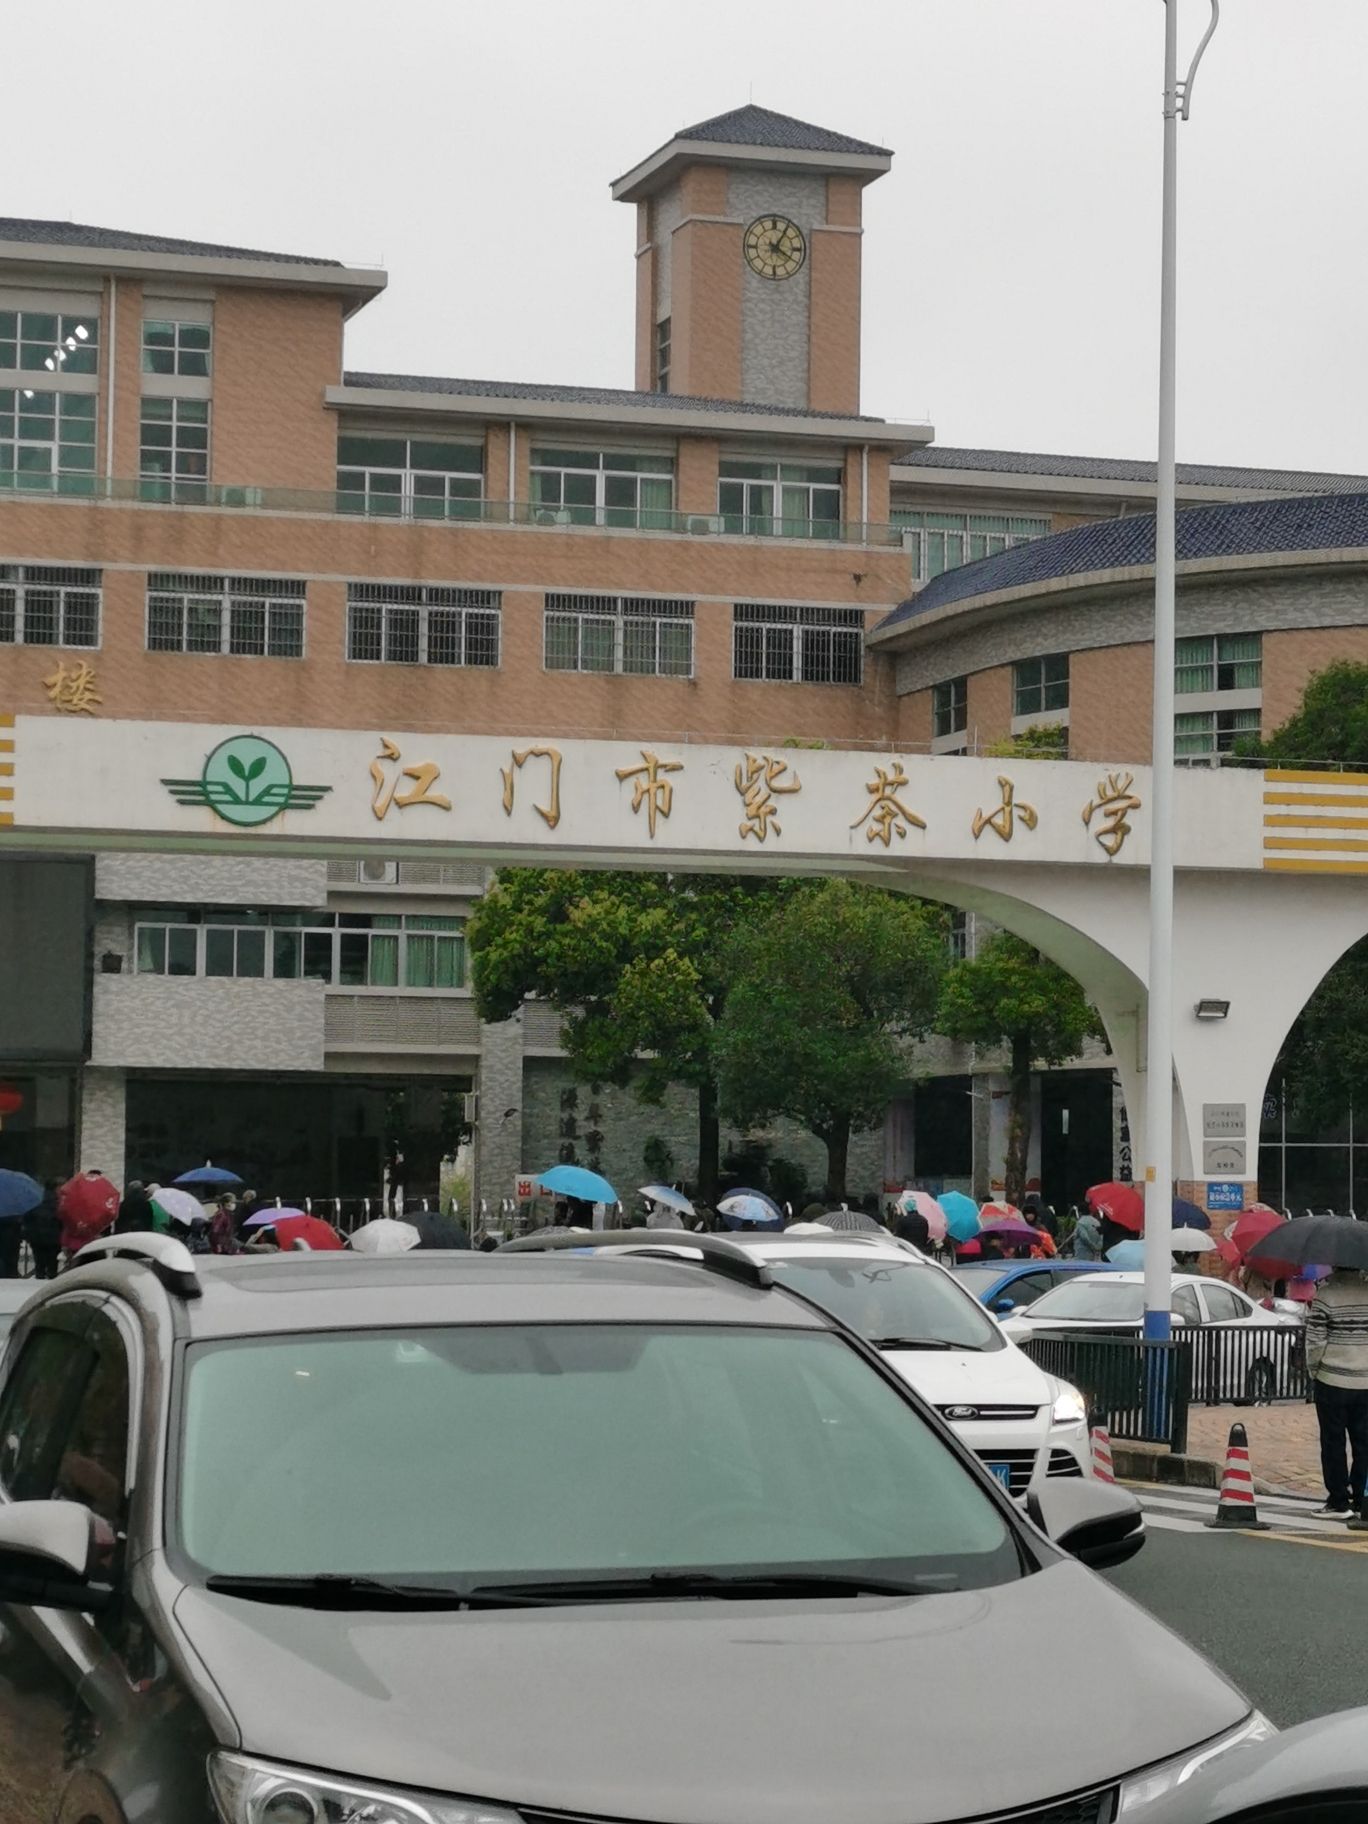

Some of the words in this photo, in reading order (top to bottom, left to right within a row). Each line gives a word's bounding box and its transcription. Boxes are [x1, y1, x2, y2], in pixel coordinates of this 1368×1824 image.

[42, 660, 103, 715] 楼
[369, 736, 1142, 857] 江门市紫茶小学
